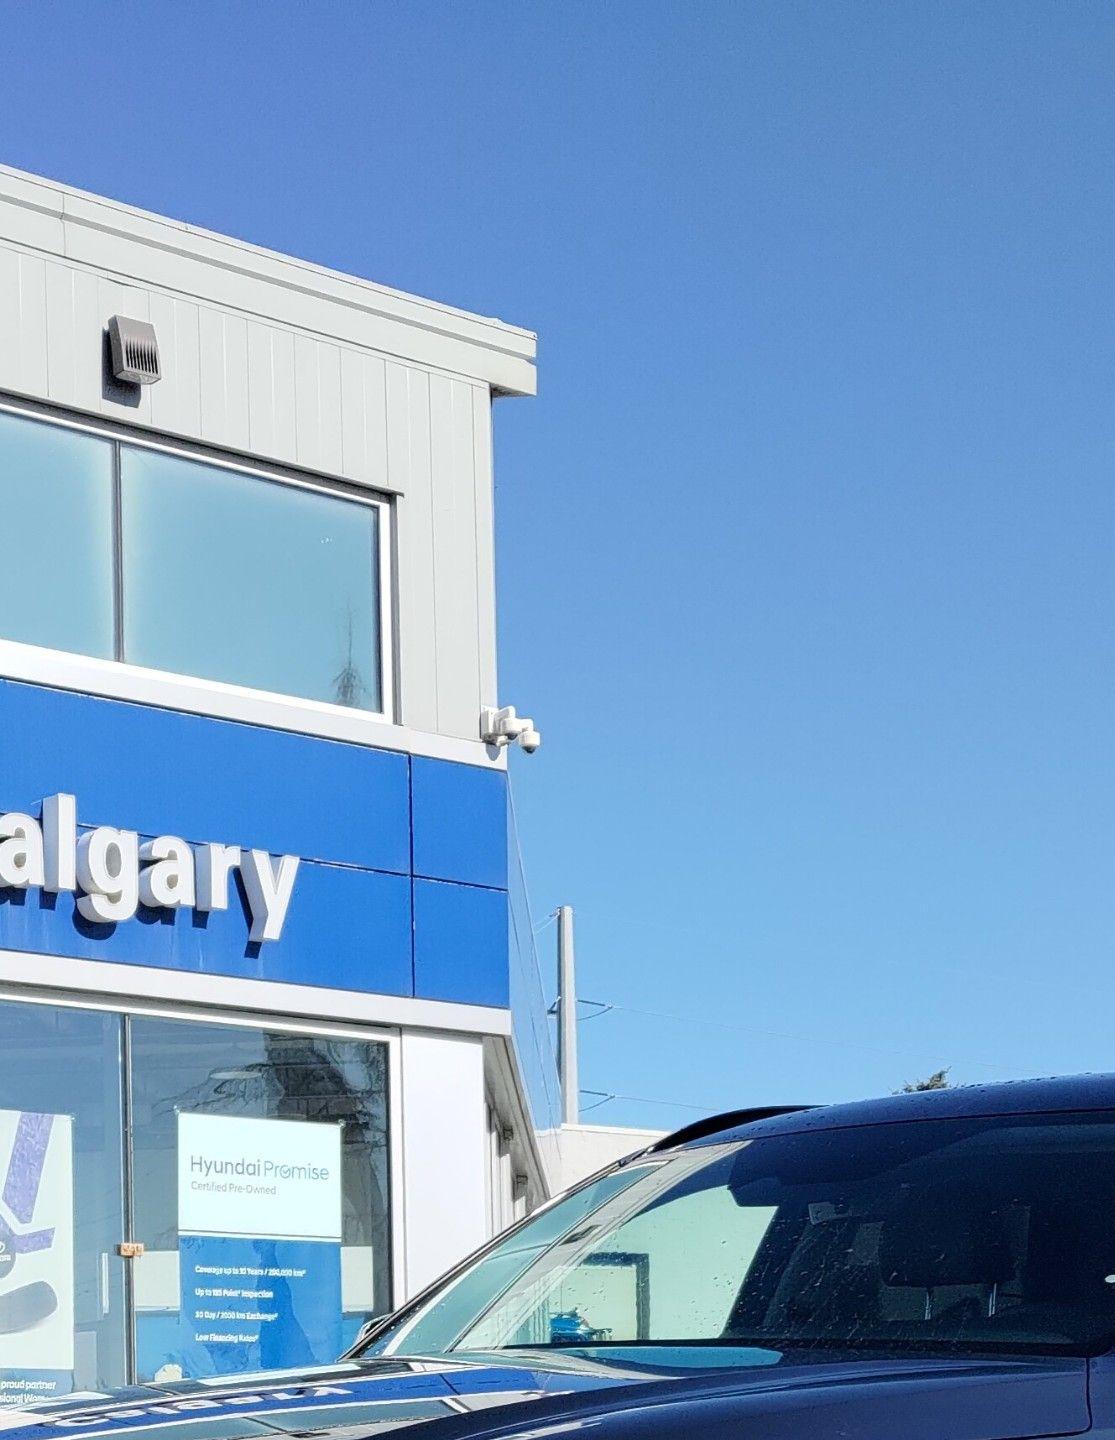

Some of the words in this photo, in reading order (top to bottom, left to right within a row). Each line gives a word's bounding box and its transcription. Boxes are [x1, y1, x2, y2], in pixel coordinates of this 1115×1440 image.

[191, 1155, 261, 1177] Hyundai
[264, 1159, 330, 1181] Promise
[191, 1180, 228, 1193] Certified
[229, 1183, 277, 1195] Pre-Owned
[1, 1380, 25, 1390] proud
[26, 1380, 56, 1390] partner
